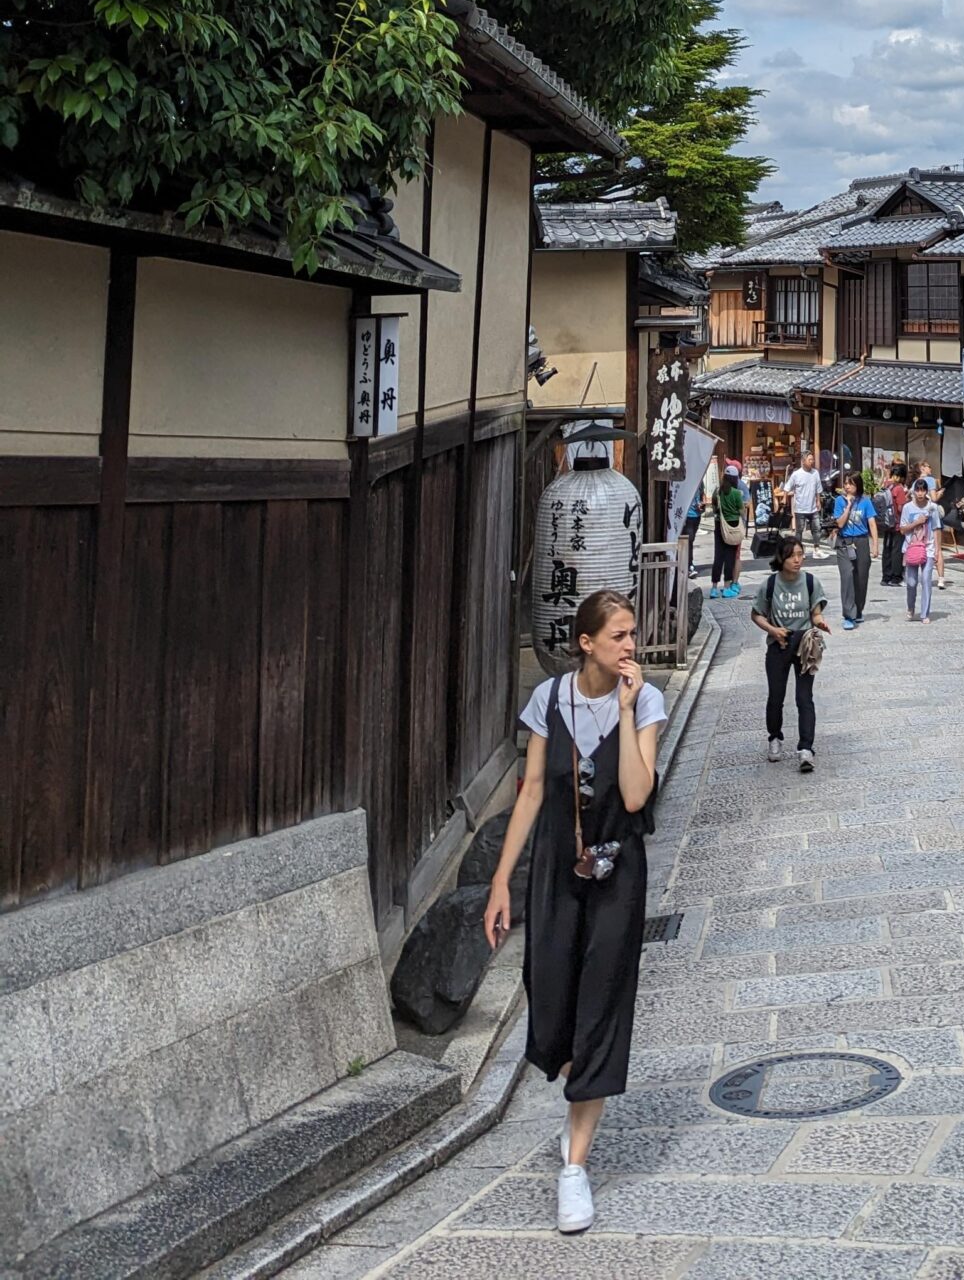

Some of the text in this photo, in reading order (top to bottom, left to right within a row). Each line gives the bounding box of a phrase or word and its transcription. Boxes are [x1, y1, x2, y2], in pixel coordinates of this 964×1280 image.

[357, 330, 372, 425] ゆどうふ 奥丹
[380, 338, 397, 412] 奥丹
[650, 417, 666, 461] 奥丹
[658, 392, 683, 472] ゆどうふ
[547, 500, 564, 558] ゆどうふ
[570, 499, 590, 552] 総本家
[784, 602, 796, 610] et
